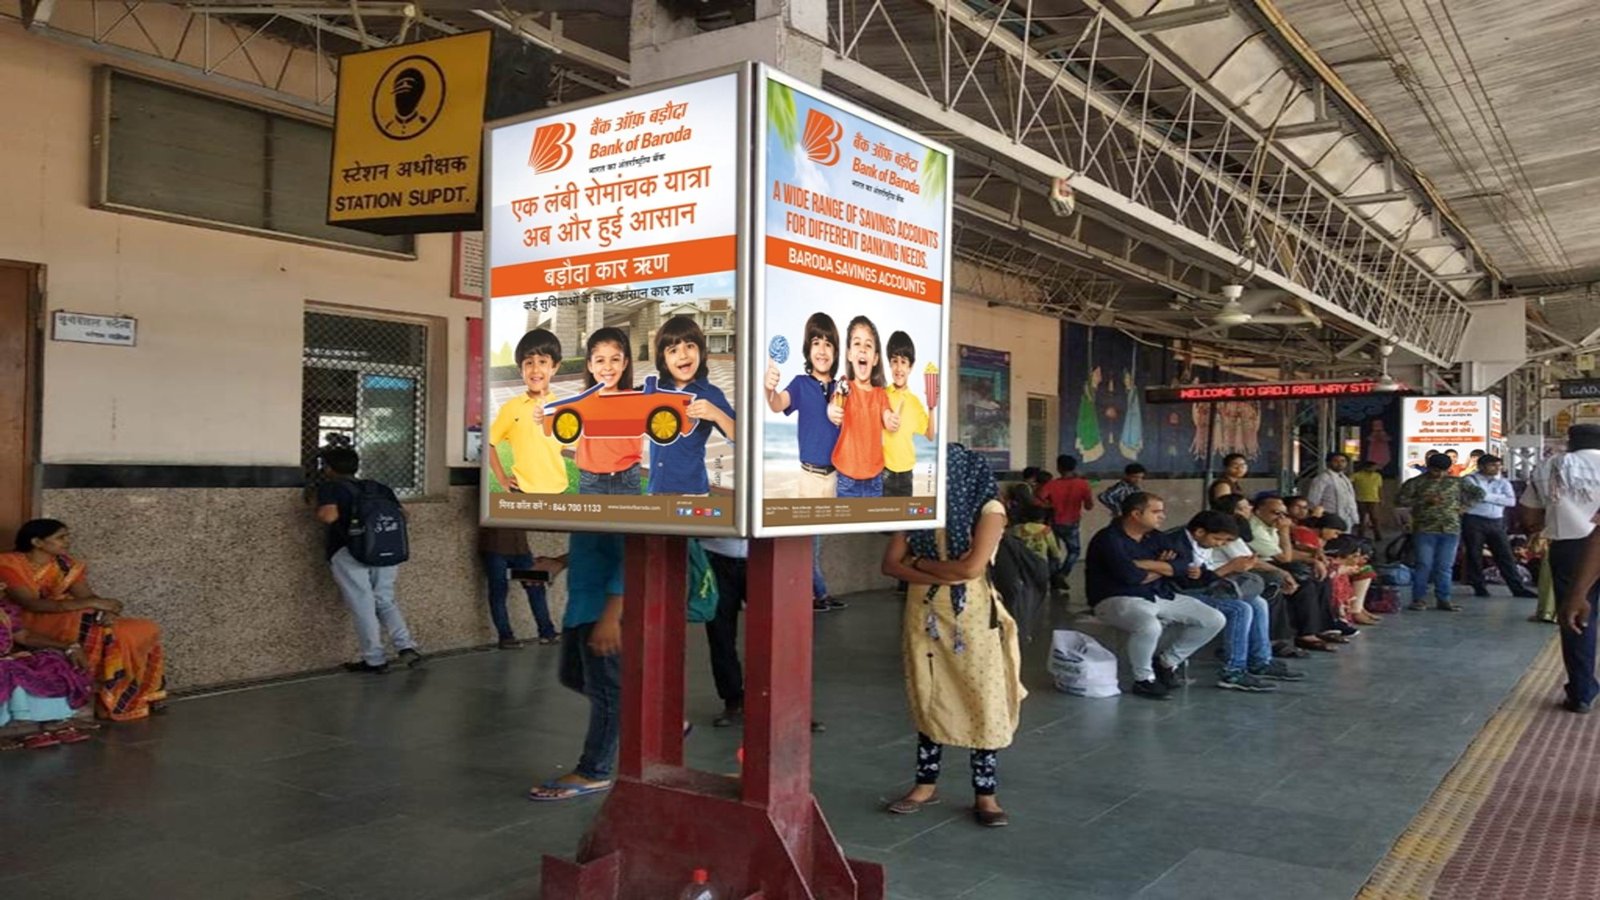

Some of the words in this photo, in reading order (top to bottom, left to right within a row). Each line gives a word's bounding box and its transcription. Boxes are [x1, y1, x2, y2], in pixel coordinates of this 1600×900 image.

[590, 117, 612, 135] बैंक
[649, 100, 689, 125] बड़ौदा
[589, 138, 624, 160] Bank
[625, 134, 641, 152] of
[640, 125, 692, 149] Baroda
[853, 131, 870, 152] बैंक
[894, 152, 919, 173] बड़ौदा
[342, 161, 390, 183] स्टेशन
[396, 153, 470, 178] अधीक्षक
[853, 157, 878, 179] Bank
[878, 169, 889, 182] of
[889, 171, 920, 195] Baroda
[335, 192, 402, 212] STATION
[409, 186, 470, 206] SUPDT.
[511, 196, 539, 222] एक
[544, 181, 579, 213] लंबी
[585, 173, 659, 206] रोमांचक
[664, 165, 712, 192] यात्रा
[523, 225, 552, 248] अब
[557, 213, 592, 242] और
[597, 206, 624, 248] हुई
[629, 203, 698, 232] आसान
[772, 181, 781, 200] A
[783, 183, 810, 211] WIDE
[812, 192, 844, 222] RANGE
[846, 203, 858, 223] OF
[859, 207, 896, 237] SAVINGS
[897, 221, 939, 250] ACCOUNTS
[786, 211, 806, 235] FOR
[809, 218, 859, 250] DIFFERENT
[860, 233, 900, 262] BANKING
[900, 246, 928, 270] NEEDS.
[544, 259, 591, 289] बड़ौदा
[595, 258, 628, 281] कार
[633, 253, 671, 275] ऋण
[788, 247, 834, 273] BARODA
[835, 259, 877, 284] SAVINGS
[878, 271, 926, 296] ACCOUNTS
[523, 297, 538, 312] कई
[540, 292, 579, 313] सुविधाओं
[650, 285, 670, 298] कार
[672, 282, 695, 295] ऋण
[1181, 388, 1237, 399] WELCOME
[1238, 387, 1256, 396] TO
[1291, 383, 1348, 395] RAILWAY
[552, 503, 566, 511] 846
[567, 503, 582, 512] 700
[583, 504, 602, 513] 1133
